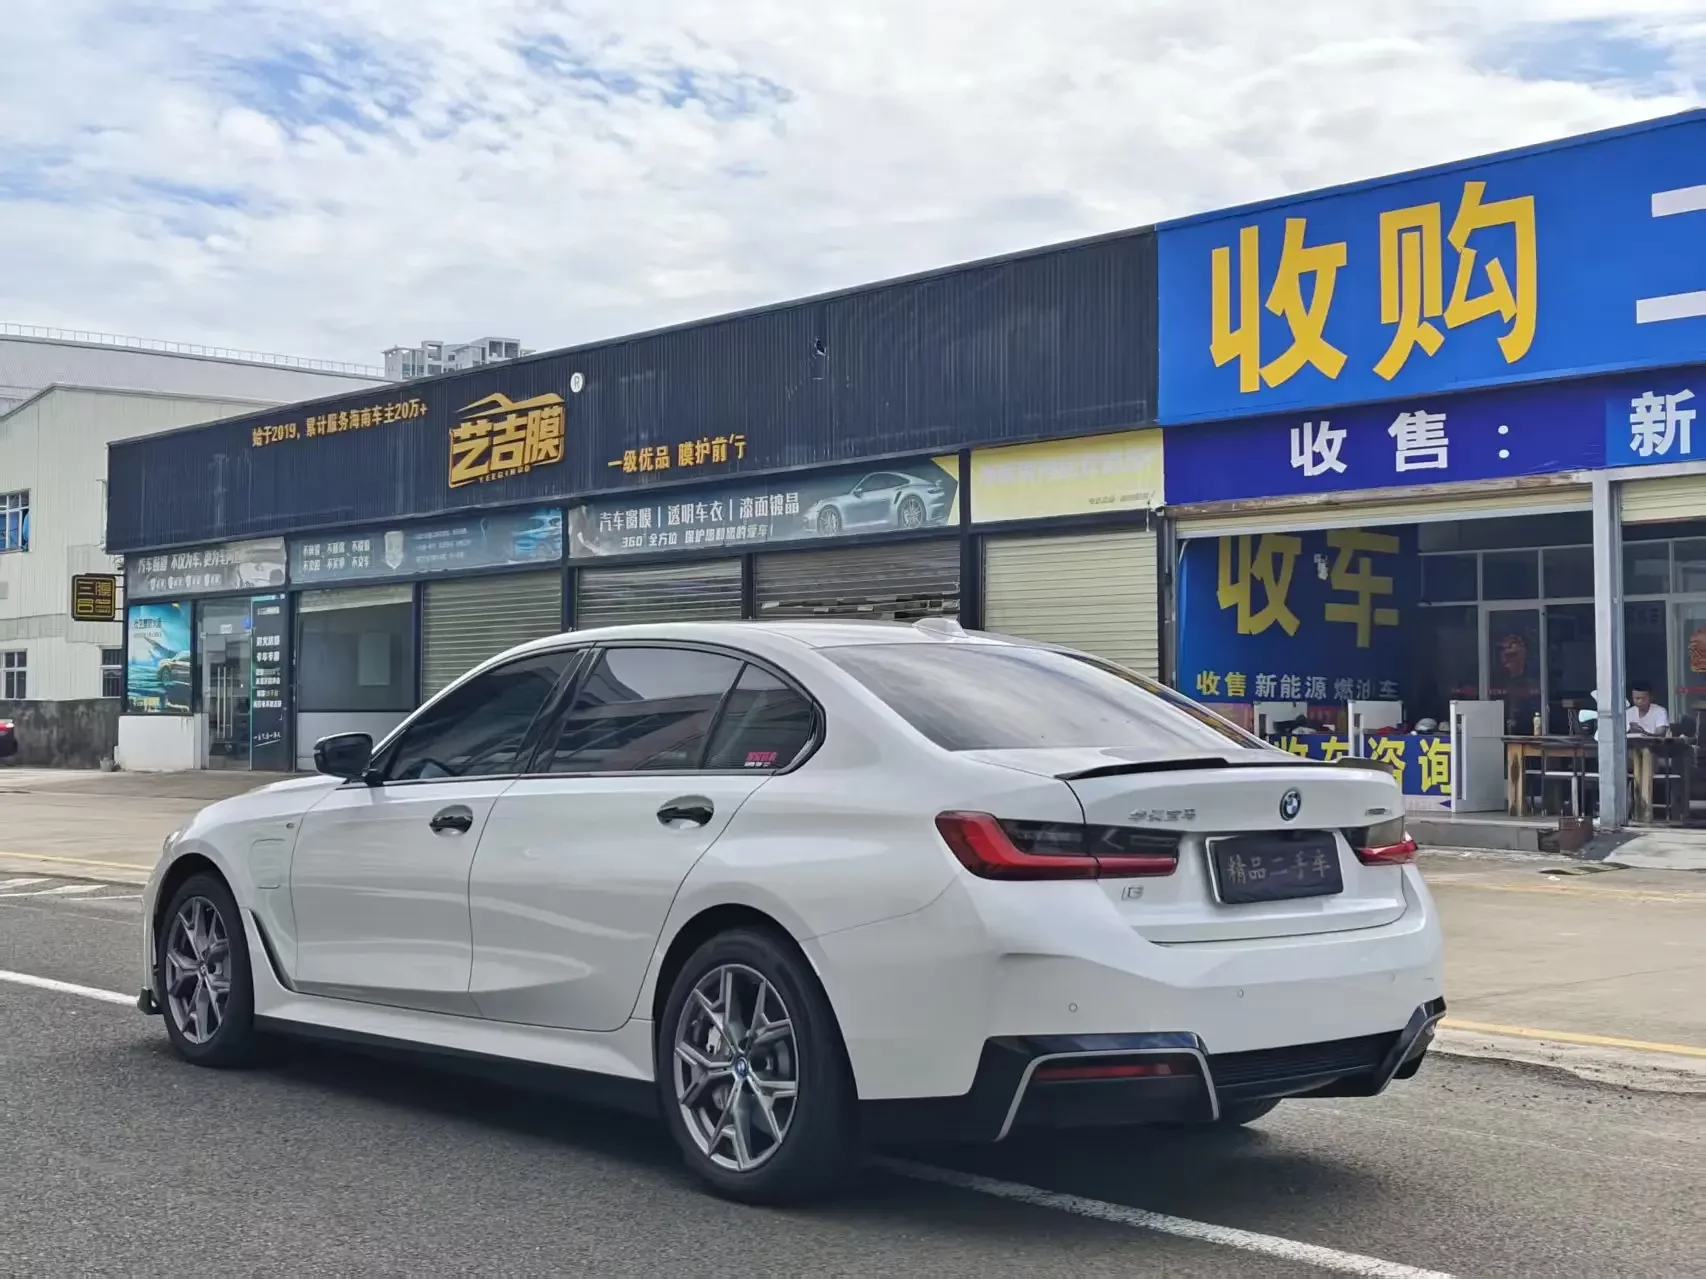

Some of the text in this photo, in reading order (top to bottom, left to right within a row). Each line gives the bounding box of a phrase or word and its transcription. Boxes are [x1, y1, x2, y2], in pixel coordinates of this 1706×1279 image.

[1209, 181, 1537, 393] 收购
[451, 405, 564, 483] 艺吉膜
[607, 445, 671, 473] 一级优品
[599, 508, 652, 533] 汽车窗膜
[667, 500, 723, 526] 透明车衣
[1196, 669, 1400, 701] 收售 新能源 燃油车
[1227, 849, 1332, 885] 精品二手车
